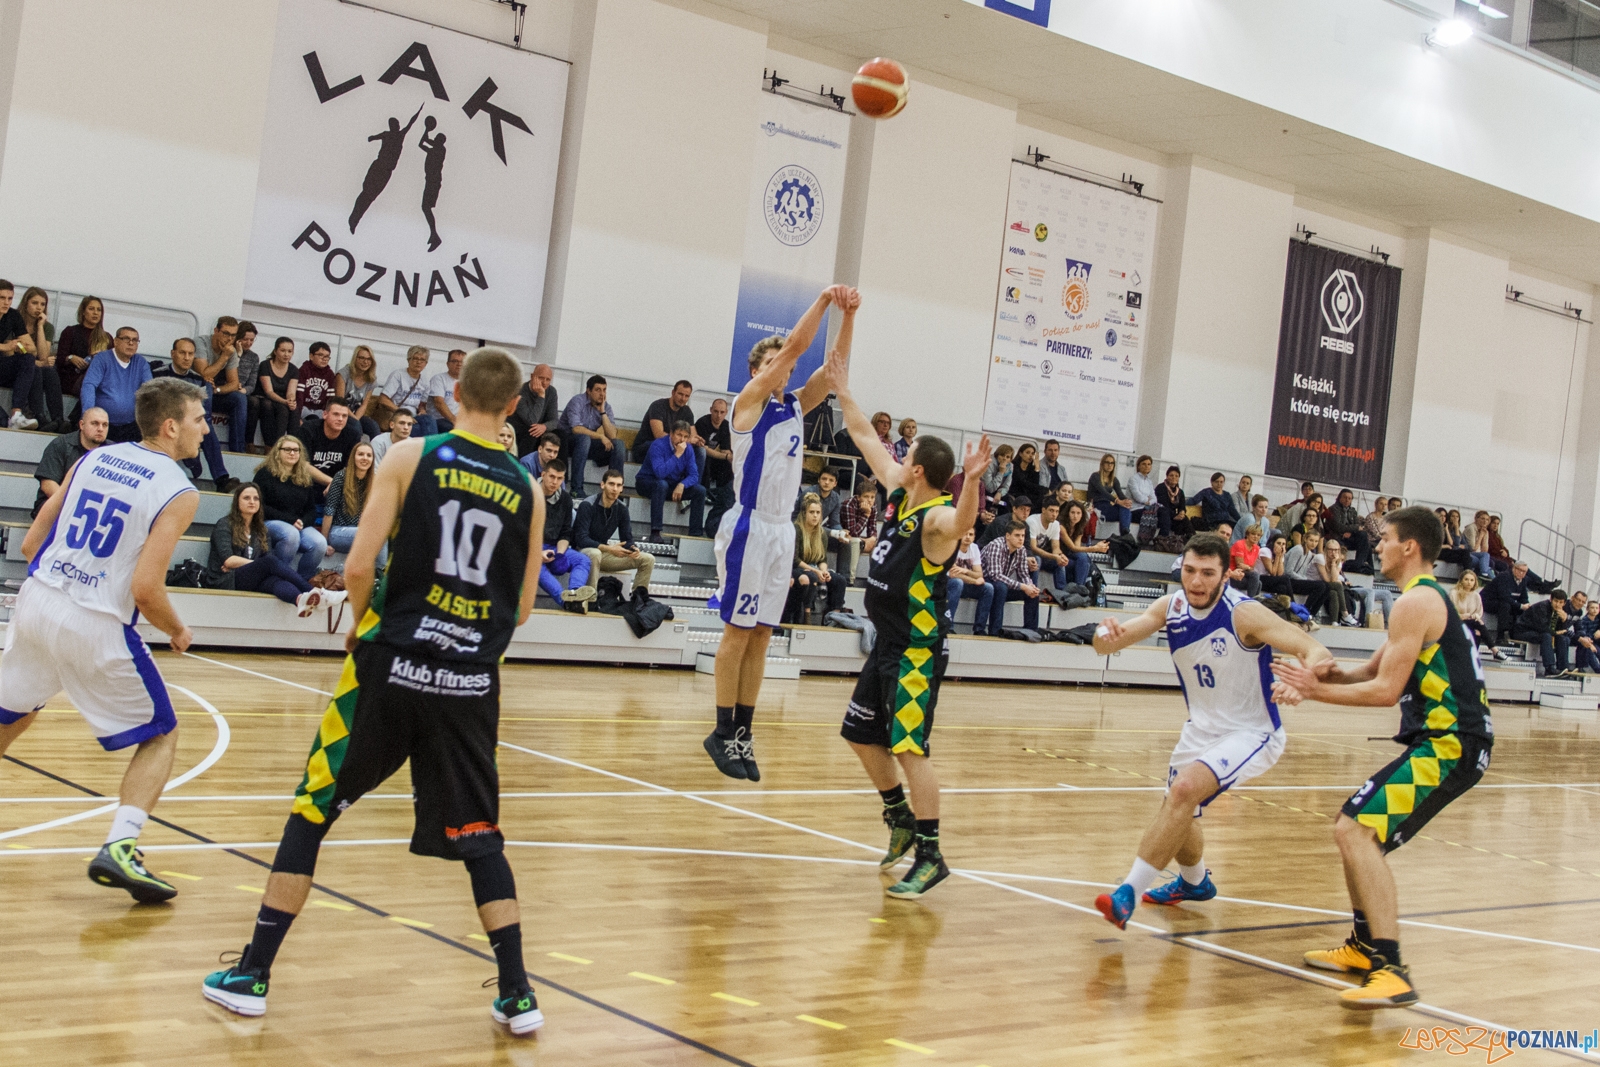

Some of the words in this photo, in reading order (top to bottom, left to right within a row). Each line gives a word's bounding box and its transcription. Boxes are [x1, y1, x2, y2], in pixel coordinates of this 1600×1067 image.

[303, 41, 534, 167] LAK
[772, 171, 787, 188] KLUB
[788, 169, 820, 197] UCZELNIANY
[766, 195, 790, 242] POLITECHNIKI
[291, 220, 489, 308] POZNAŃ
[1042, 326, 1070, 337] Dołącz
[1072, 322, 1083, 332] do
[1085, 318, 1101, 329] nas!
[1064, 310, 1075, 320] KLUB
[1046, 339, 1093, 360] PARTNERZY:
[1320, 336, 1354, 355] REBIS
[1292, 373, 1337, 397] Książki,
[1290, 397, 1320, 417] które
[1322, 405, 1339, 423] się
[1341, 409, 1370, 427] czyta
[1042, 429, 1081, 441] www.azs.poznan.pl
[1278, 434, 1375, 463] www.rebis.com.pl
[91, 465, 140, 490] POZNAŃSKA
[97, 453, 156, 481] POLITECHNIKA
[434, 468, 522, 514] TARNOVIA
[66, 488, 132, 559] 55
[434, 499, 503, 586] 10
[737, 593, 759, 616] 23
[391, 656, 432, 683] klub
[435, 668, 490, 688] fitness
[1193, 663, 1215, 689] 13
